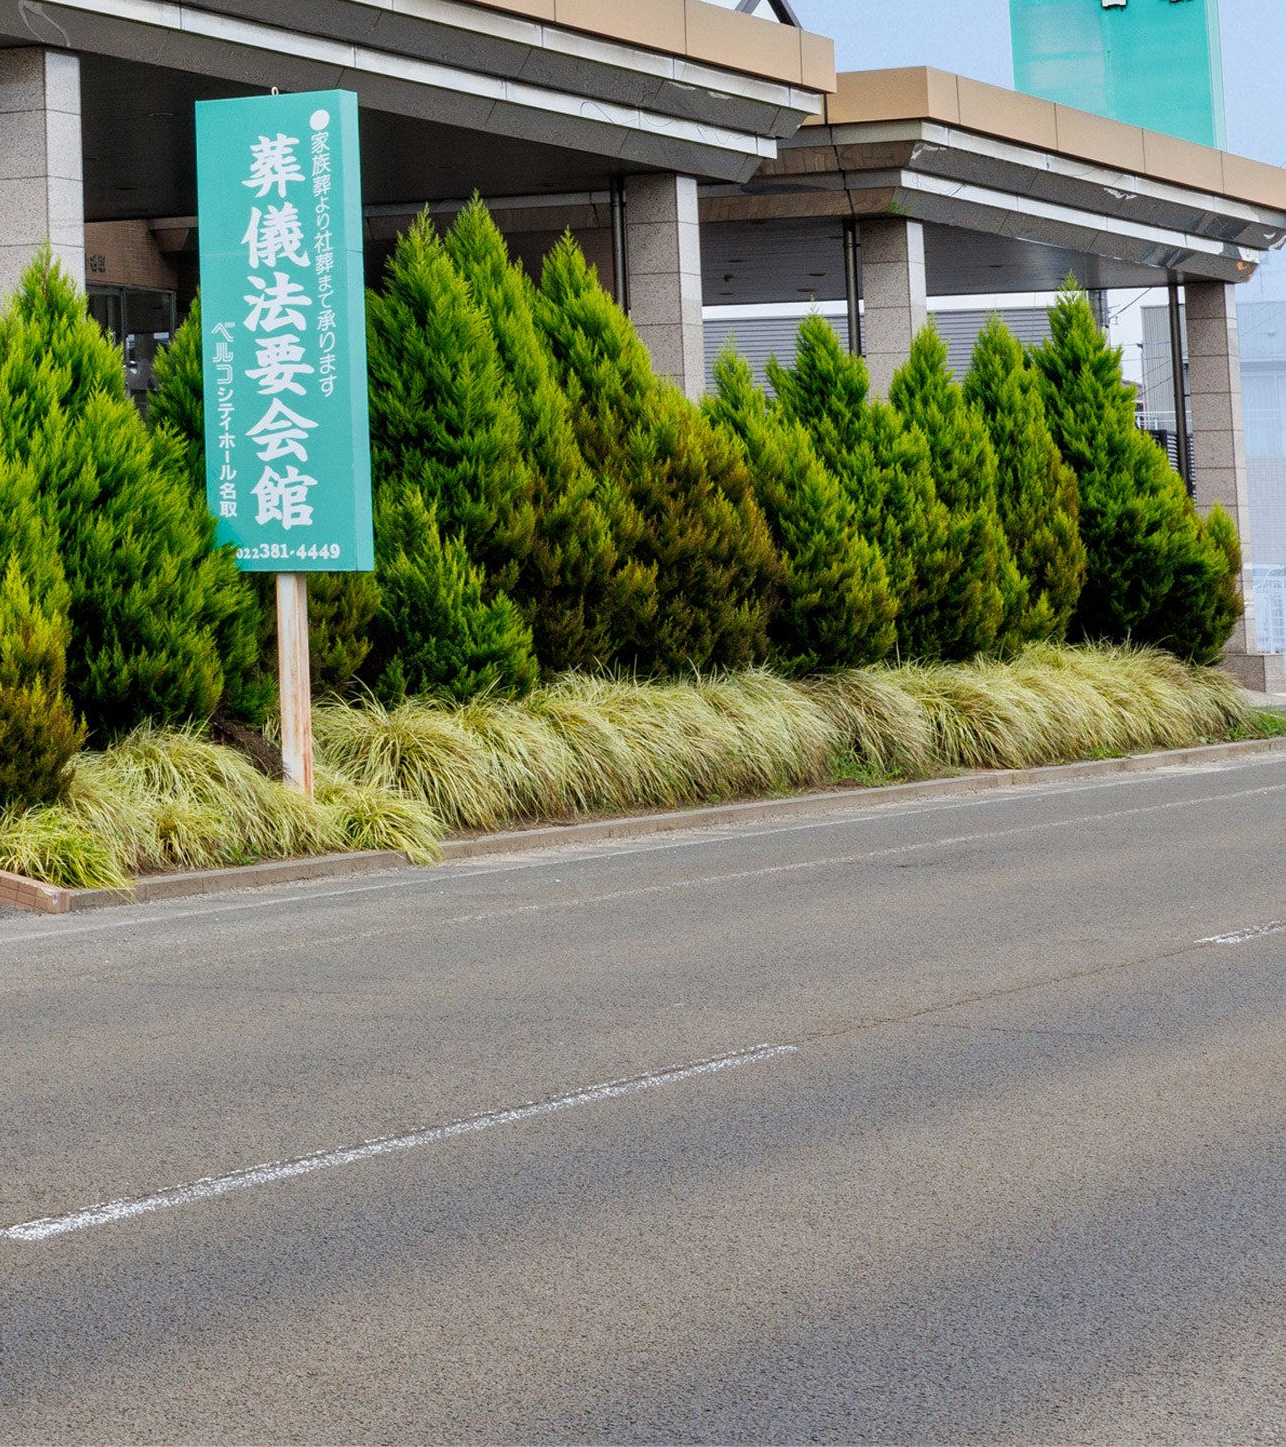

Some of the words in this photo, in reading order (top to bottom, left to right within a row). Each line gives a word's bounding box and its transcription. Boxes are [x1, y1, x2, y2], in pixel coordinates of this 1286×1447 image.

[240, 133, 320, 531] 葬儀法要会館
[311, 131, 338, 398] 家族葬より社葬まで承ります
